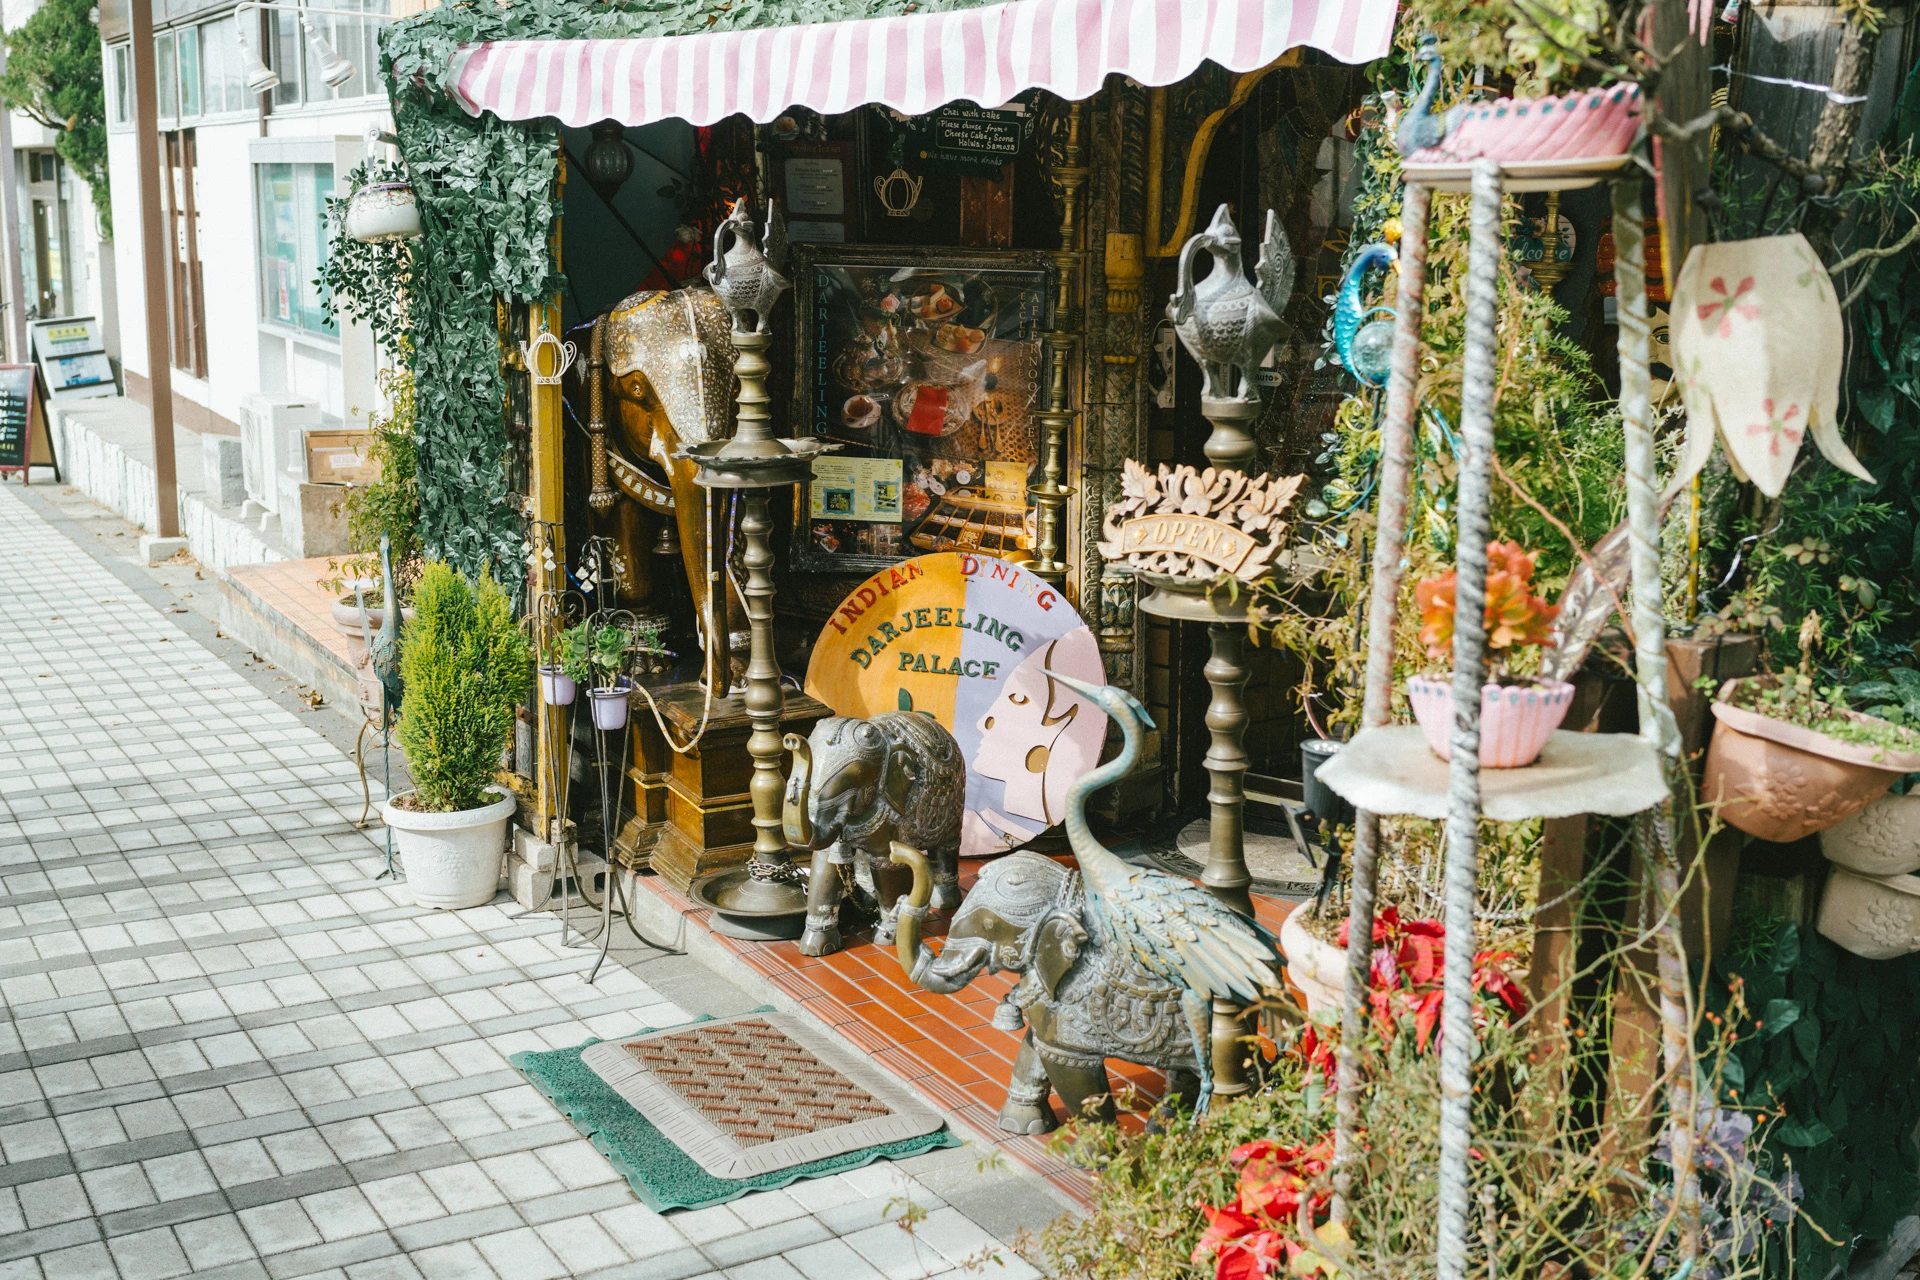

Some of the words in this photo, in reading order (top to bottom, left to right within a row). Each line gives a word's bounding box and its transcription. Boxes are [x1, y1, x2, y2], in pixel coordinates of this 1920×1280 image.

[940, 120, 960, 129] Please
[962, 121, 982, 131] choose
[984, 124, 1004, 133] from
[942, 108, 959, 117] Chai
[962, 109, 979, 118] with
[981, 110, 1001, 120] cake
[944, 129, 969, 138] Cheese
[993, 133, 1014, 143] Scone
[986, 141, 1015, 151] Samosa
[927, 151, 937, 160] We
[940, 151, 958, 161] have
[981, 155, 1003, 166] drinks
[1018, 291, 1027, 377] EXCLUSIVE
[1028, 293, 1040, 404] AFTERNOON
[815, 274, 830, 434] DARJEELING
[1026, 414, 1036, 450] TEA
[1152, 521, 1224, 554] OPEN
[829, 560, 924, 635] INDIAN
[960, 555, 1057, 611] DINING
[850, 607, 1024, 670] DARJEELING
[899, 651, 1001, 681] PALACE
